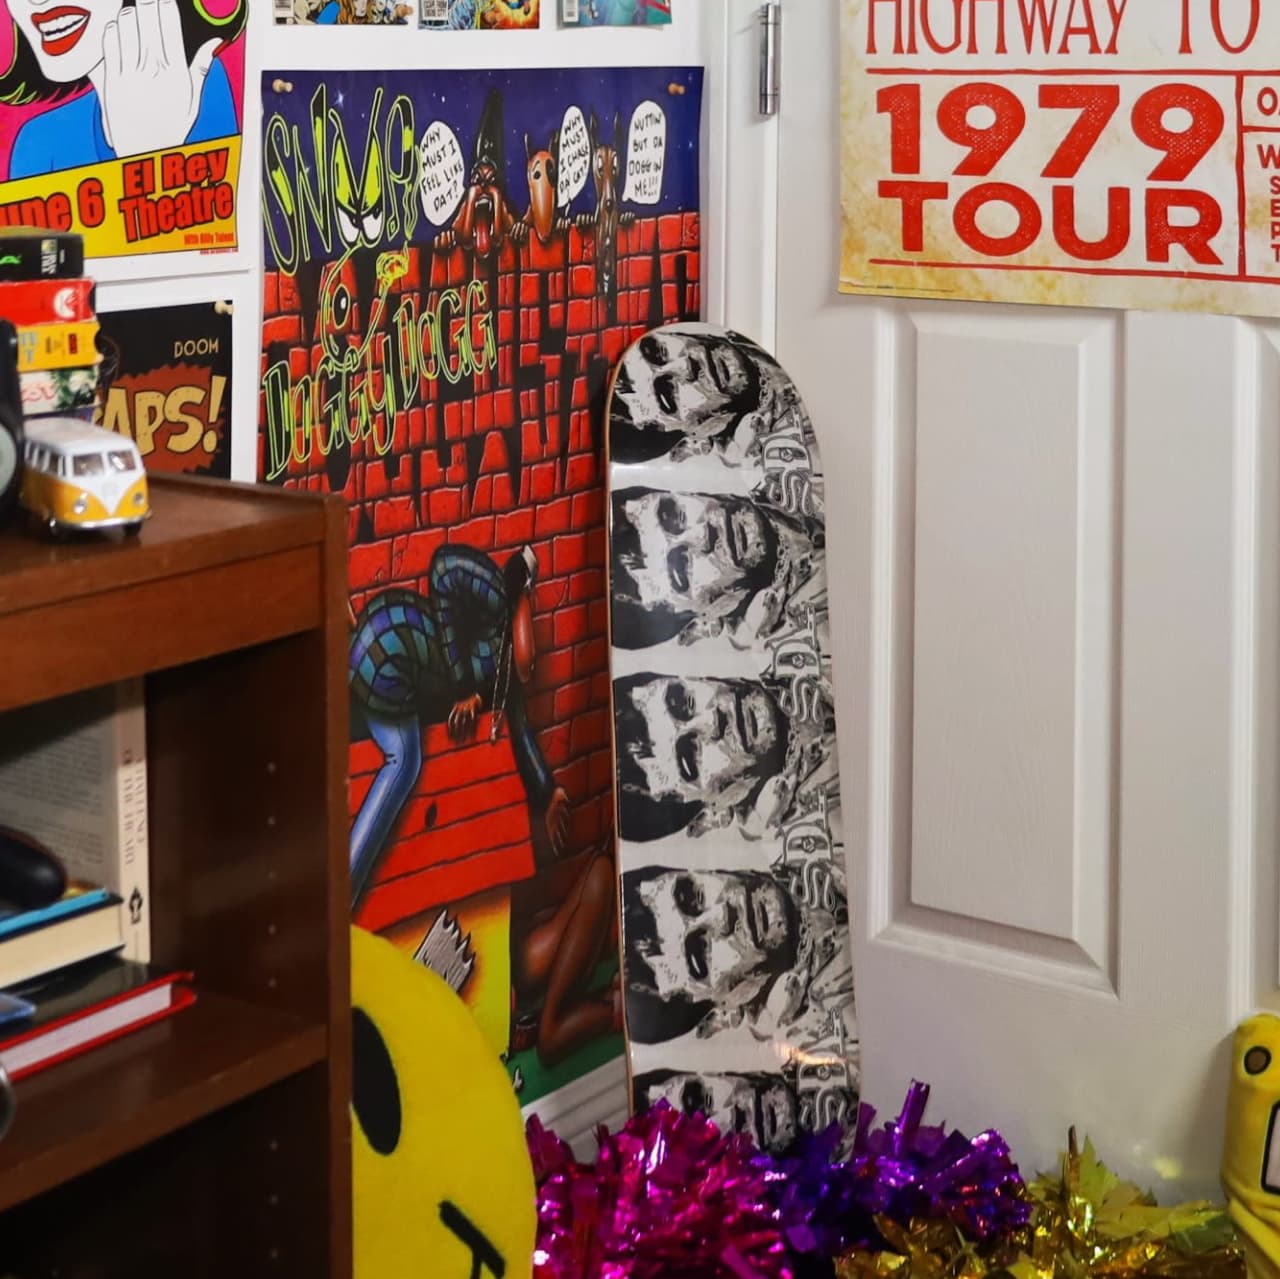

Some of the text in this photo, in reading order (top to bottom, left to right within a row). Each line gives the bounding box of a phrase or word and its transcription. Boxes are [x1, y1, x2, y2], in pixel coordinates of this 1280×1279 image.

[420, 127, 441, 152] WHY
[561, 129, 587, 150] MUST
[563, 114, 582, 134] WHY
[875, 81, 1225, 182] 1979
[422, 139, 458, 171] MUST I
[632, 134, 664, 152] BUT DA
[122, 146, 230, 199] El Rey
[421, 162, 464, 195] FEEL LIKE
[559, 161, 567, 175] I
[76, 177, 106, 229] 6
[117, 181, 235, 244] Theatre
[433, 180, 460, 213] DAT?
[877, 180, 1224, 266] TOUR
[173, 337, 219, 359] DOOM
[93, 375, 227, 456] APS!
